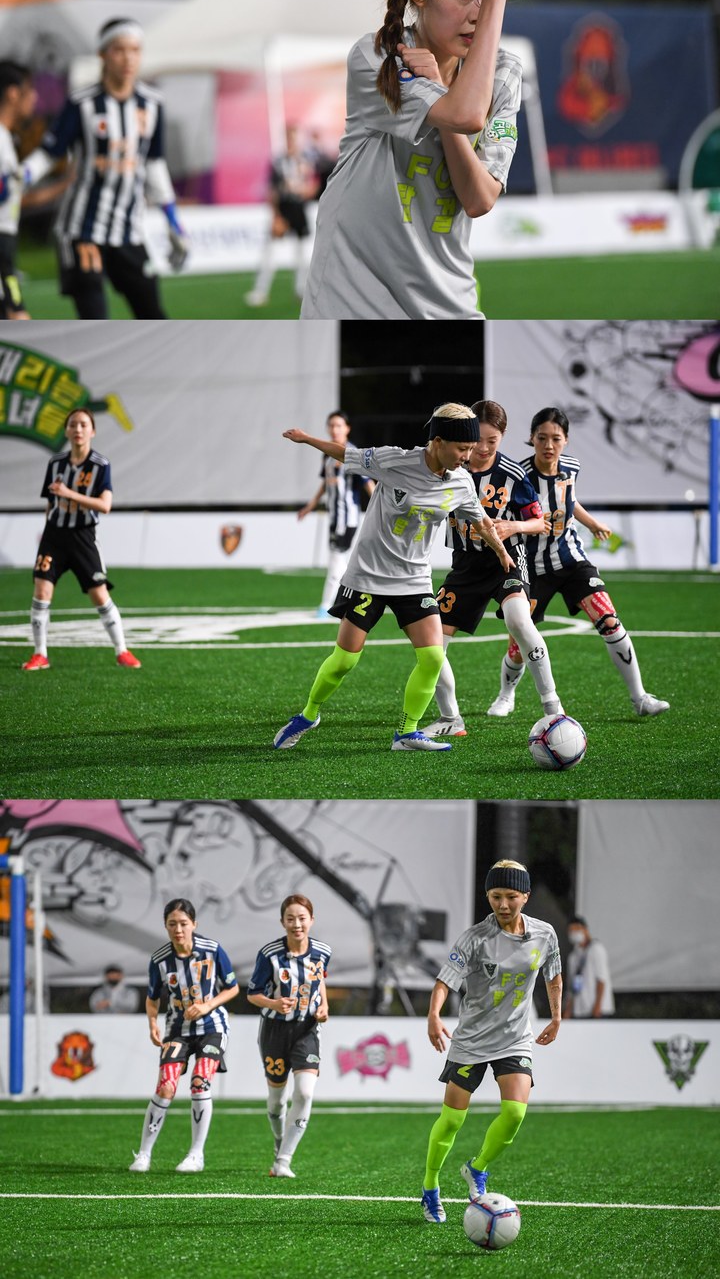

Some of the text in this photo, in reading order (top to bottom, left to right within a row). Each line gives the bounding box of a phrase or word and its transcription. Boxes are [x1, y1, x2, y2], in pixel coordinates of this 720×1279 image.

[440, 488, 455, 511] 2
[481, 484, 509, 509] 23
[353, 593, 373, 617] 2
[192, 958, 213, 981] 77
[530, 948, 541, 970] 2
[307, 961, 323, 982] 23
[501, 973, 527, 987] FC
[265, 1056, 285, 1076] 23
